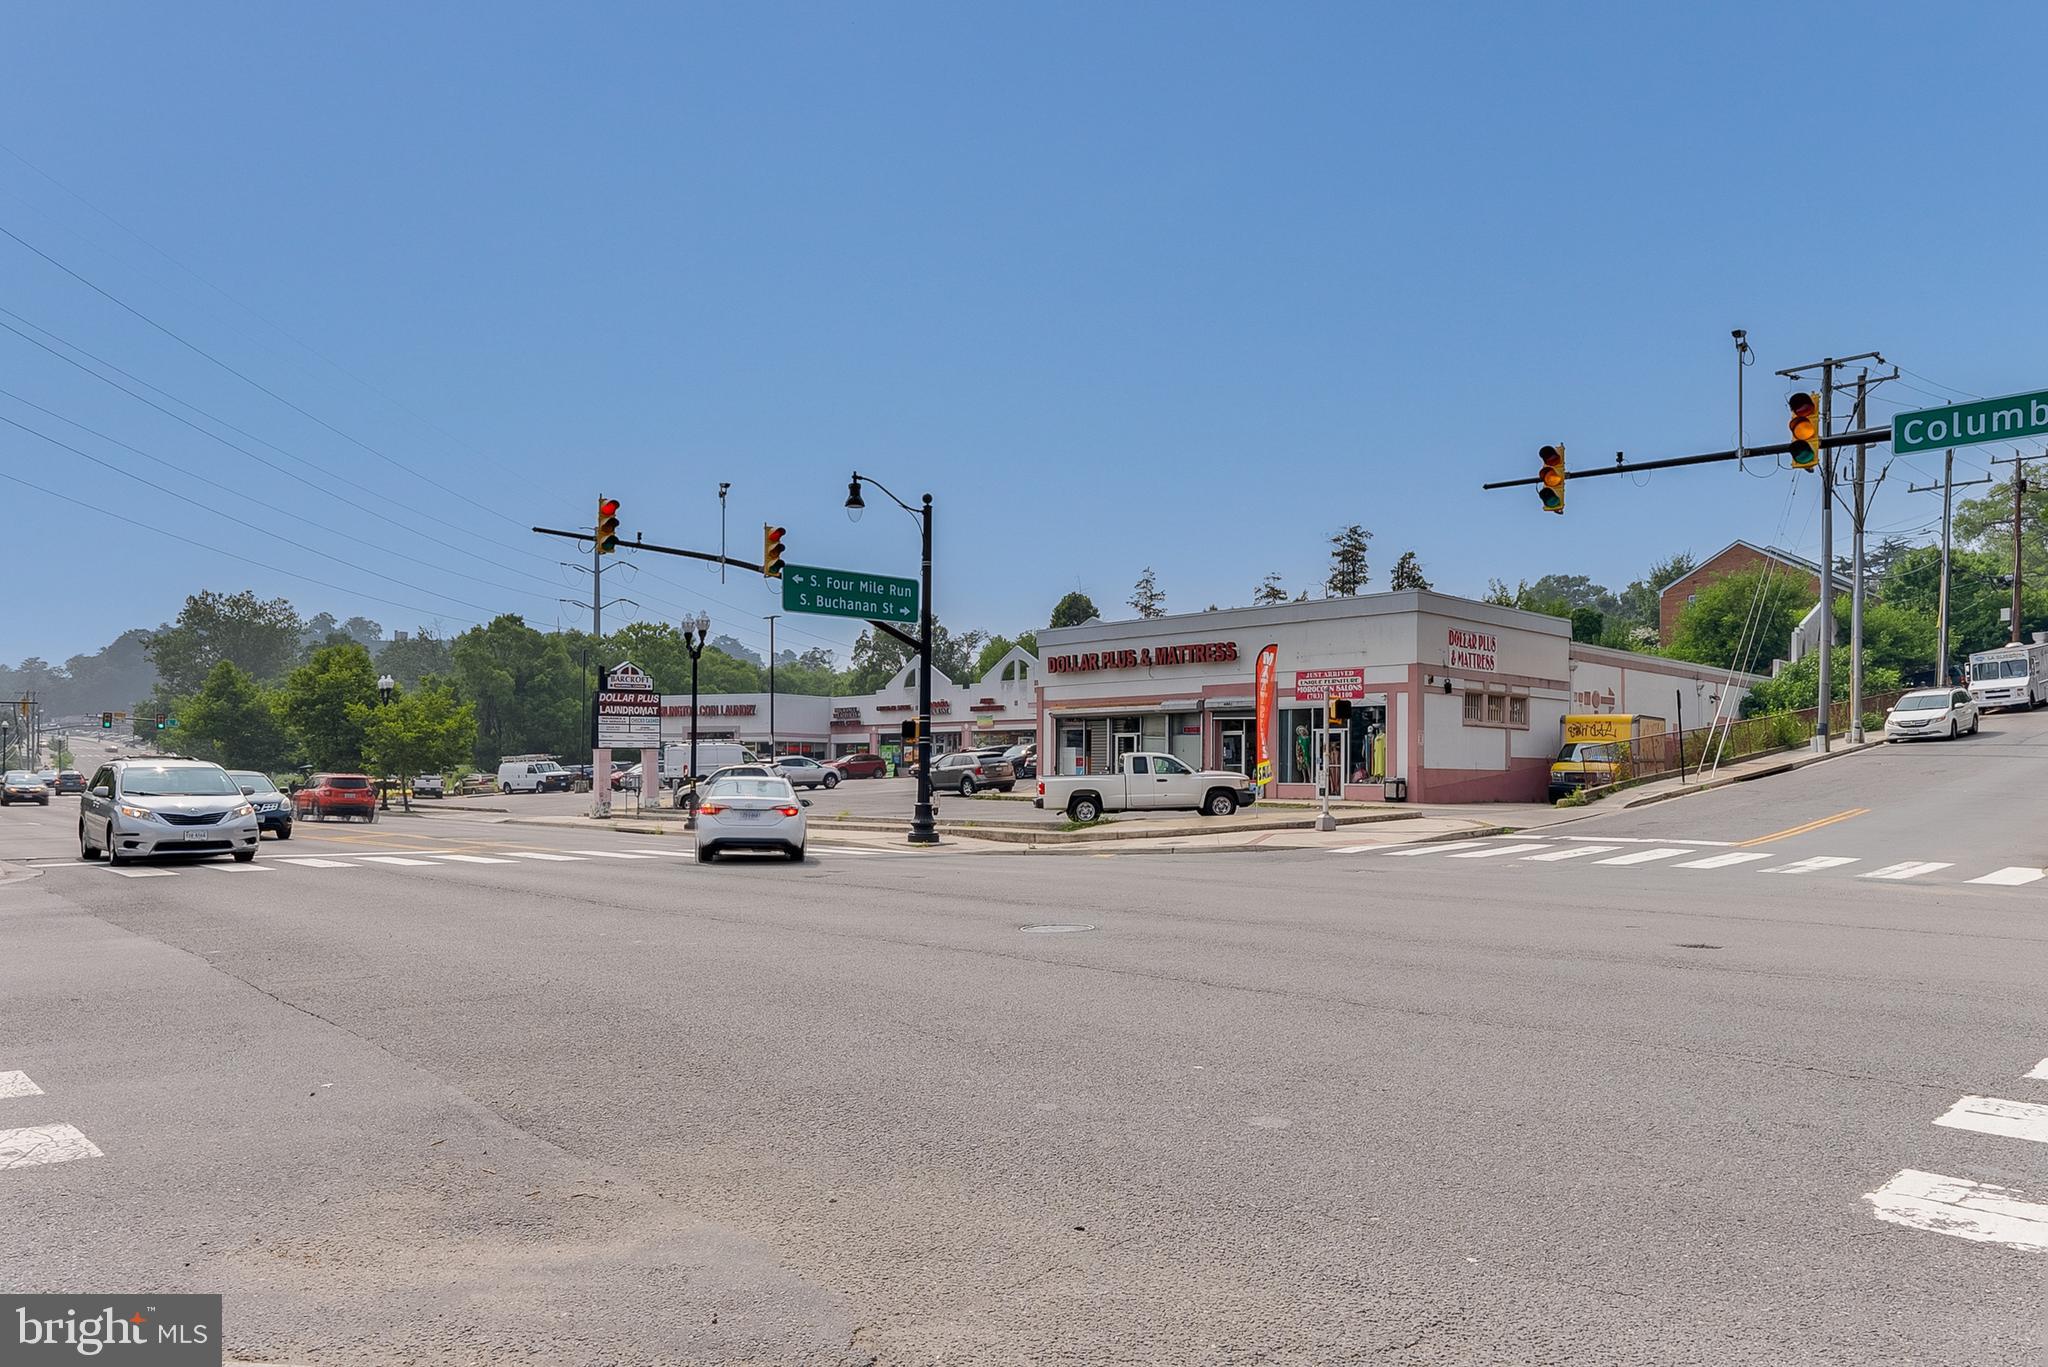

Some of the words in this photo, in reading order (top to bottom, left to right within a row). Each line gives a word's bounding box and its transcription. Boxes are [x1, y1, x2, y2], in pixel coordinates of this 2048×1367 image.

[810, 575, 821, 588] S.
[826, 577, 854, 591] Four
[859, 580, 884, 595] Mile
[890, 584, 912, 598] Run
[800, 593, 811, 606] S.
[816, 595, 877, 613] Buchanan
[882, 602, 894, 615] St
[1449, 630, 1477, 650] DOLLAR
[1479, 635, 1496, 653] PLUS
[1047, 652, 1100, 674] DOLLAR
[1101, 649, 1138, 669] PLUS
[1140, 647, 1152, 667] &
[1154, 641, 1238, 665] MATTRESS
[1458, 651, 1495, 671] MATTRESS
[1323, 670, 1354, 678] ARRIVED
[599, 693, 635, 702] DOLLAR
[637, 695, 660, 703] PLUS
[1297, 685, 1335, 693] MOROCCN
[1335, 684, 1363, 692] SALONS
[599, 705, 658, 715] LAUNDROMAT
